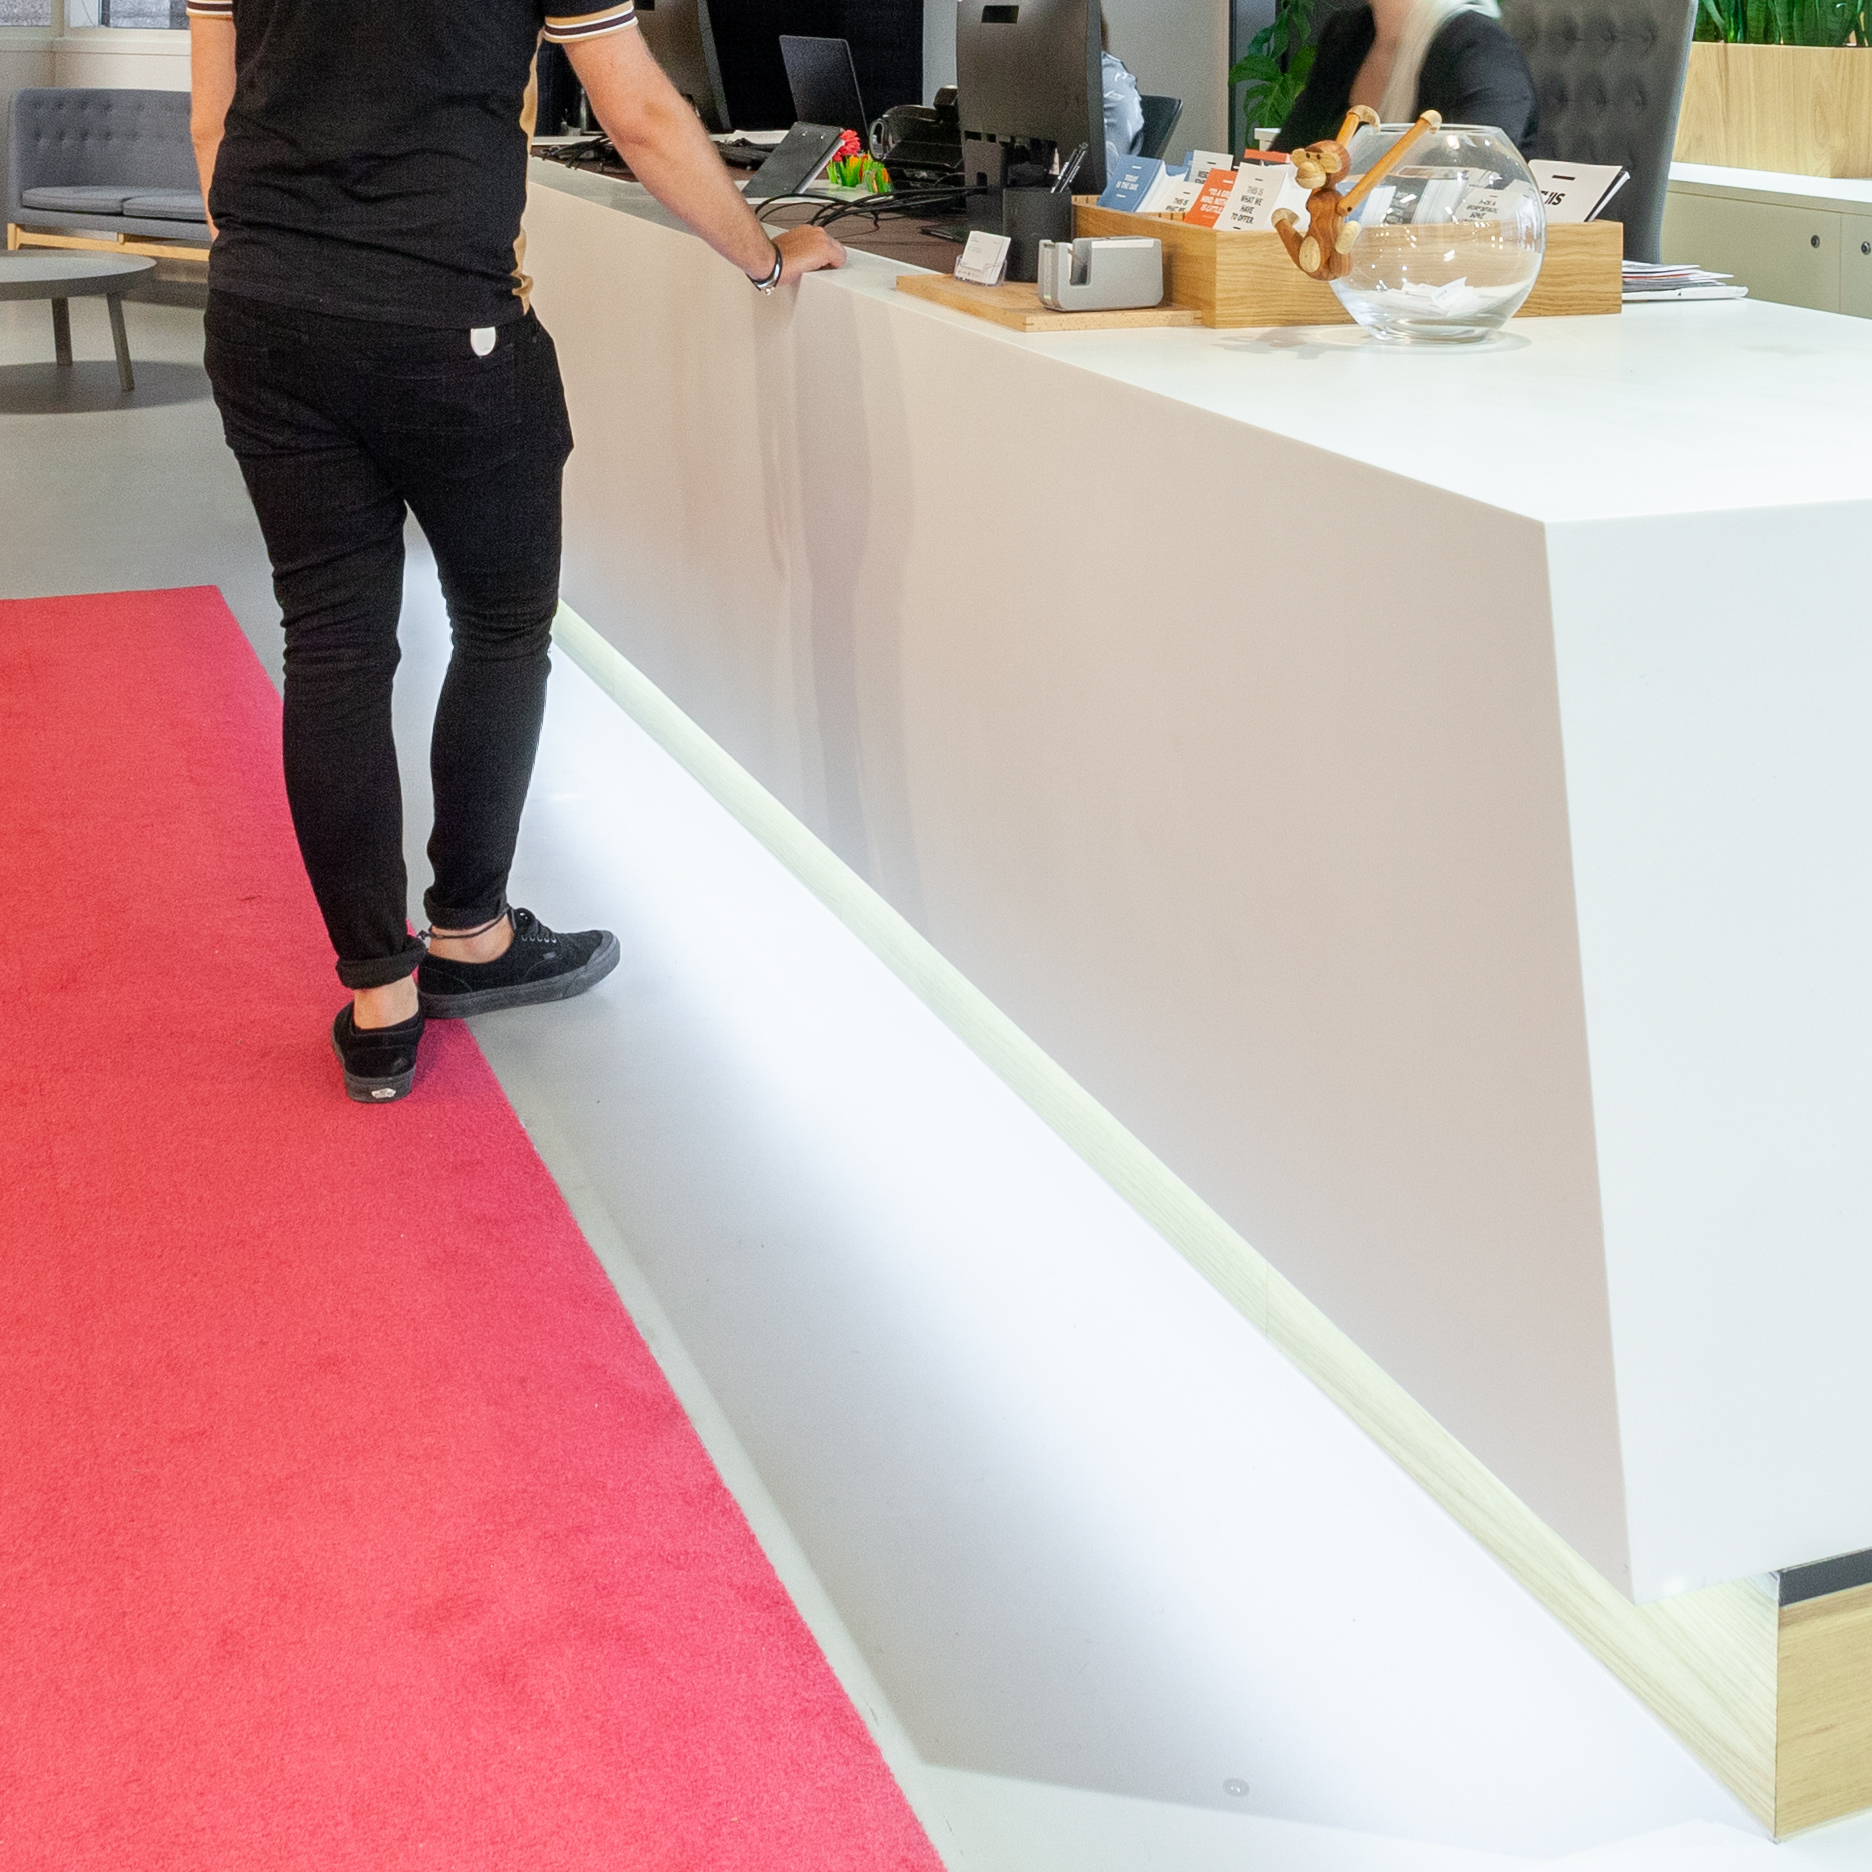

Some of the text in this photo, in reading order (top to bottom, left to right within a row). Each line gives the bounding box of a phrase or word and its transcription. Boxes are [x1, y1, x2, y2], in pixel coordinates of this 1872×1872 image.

[1247, 185, 1264, 196] THIS IS
[1240, 194, 1255, 204] WHAT
[1254, 197, 1264, 206] WE
[1240, 204, 1255, 214] HAVE
[1231, 212, 1239, 220] TO
